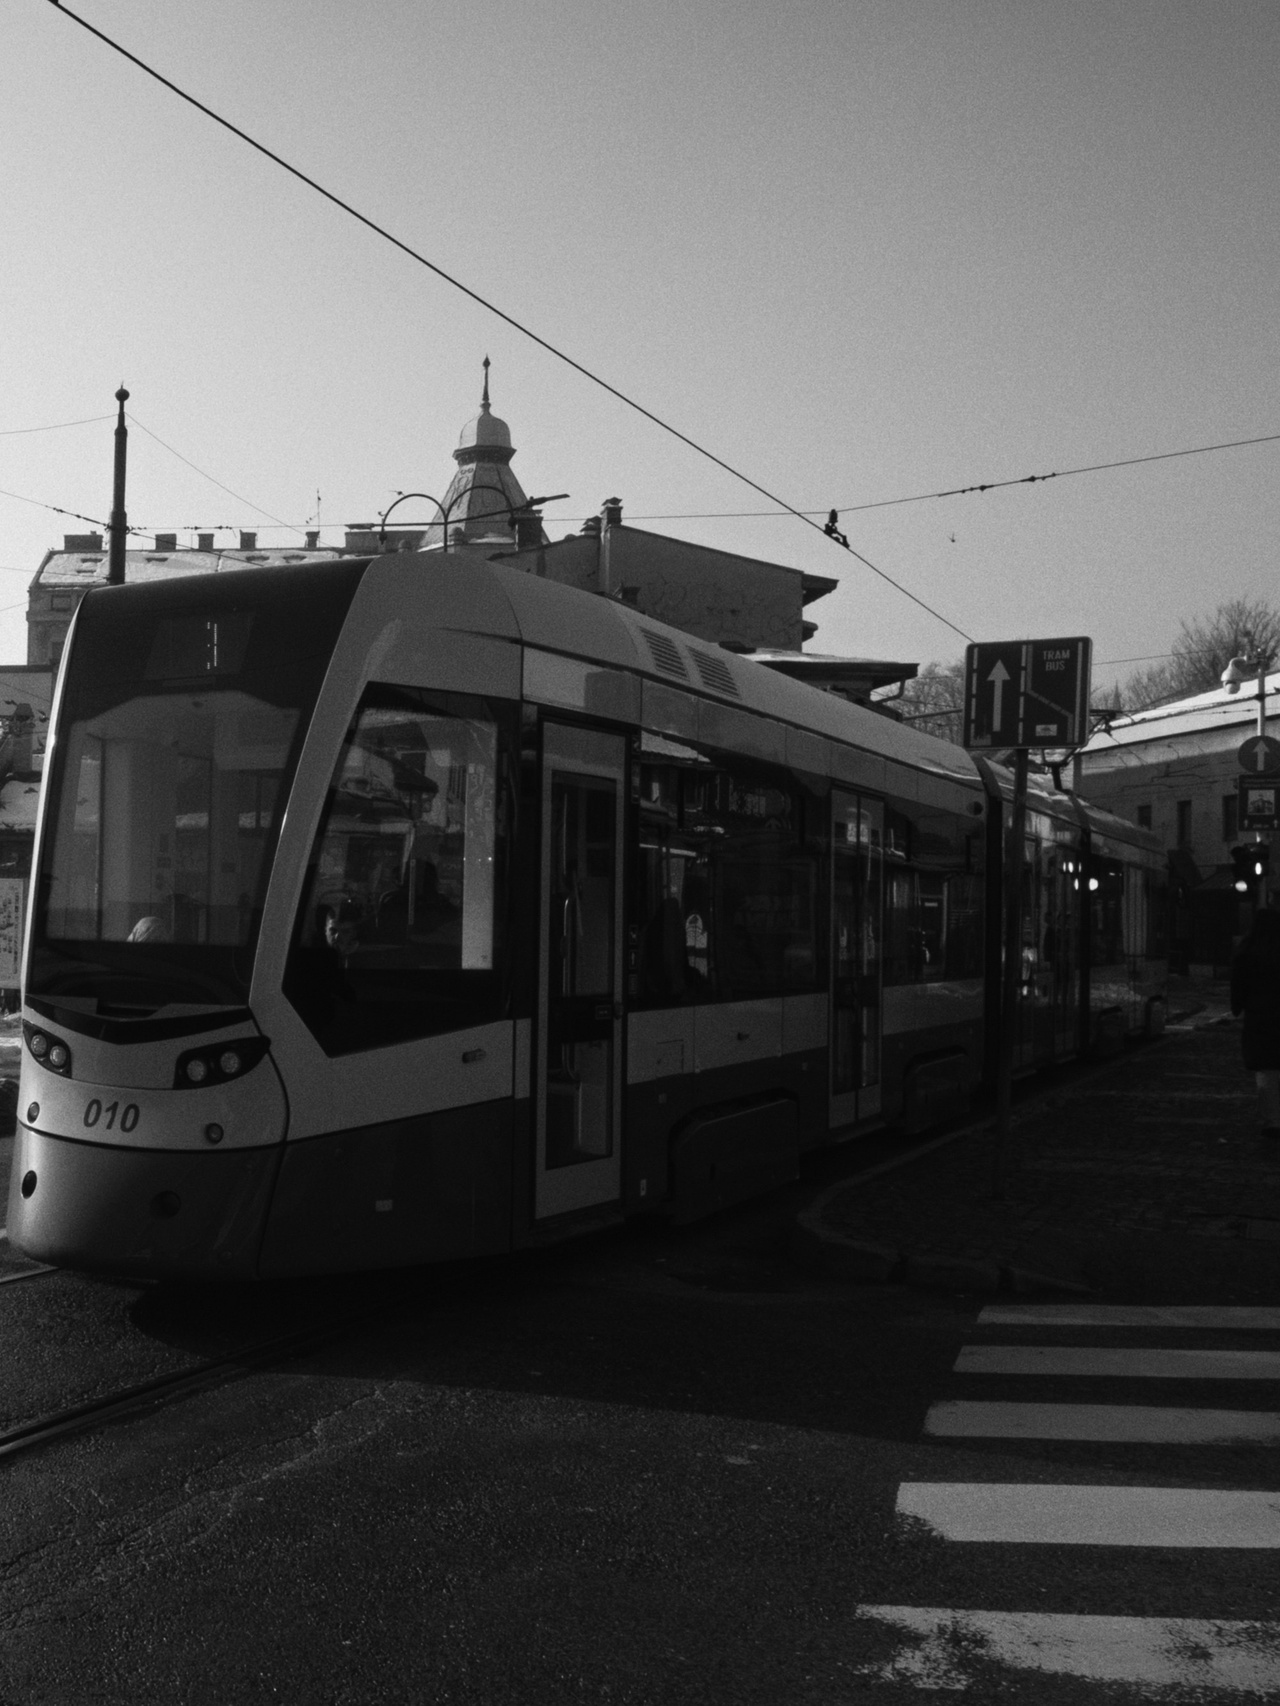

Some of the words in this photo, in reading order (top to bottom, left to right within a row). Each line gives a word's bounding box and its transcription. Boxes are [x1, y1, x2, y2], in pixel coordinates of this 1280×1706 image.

[1043, 649, 1070, 660] TRAM
[1045, 660, 1065, 671] BUS
[83, 1099, 140, 1133] 010
